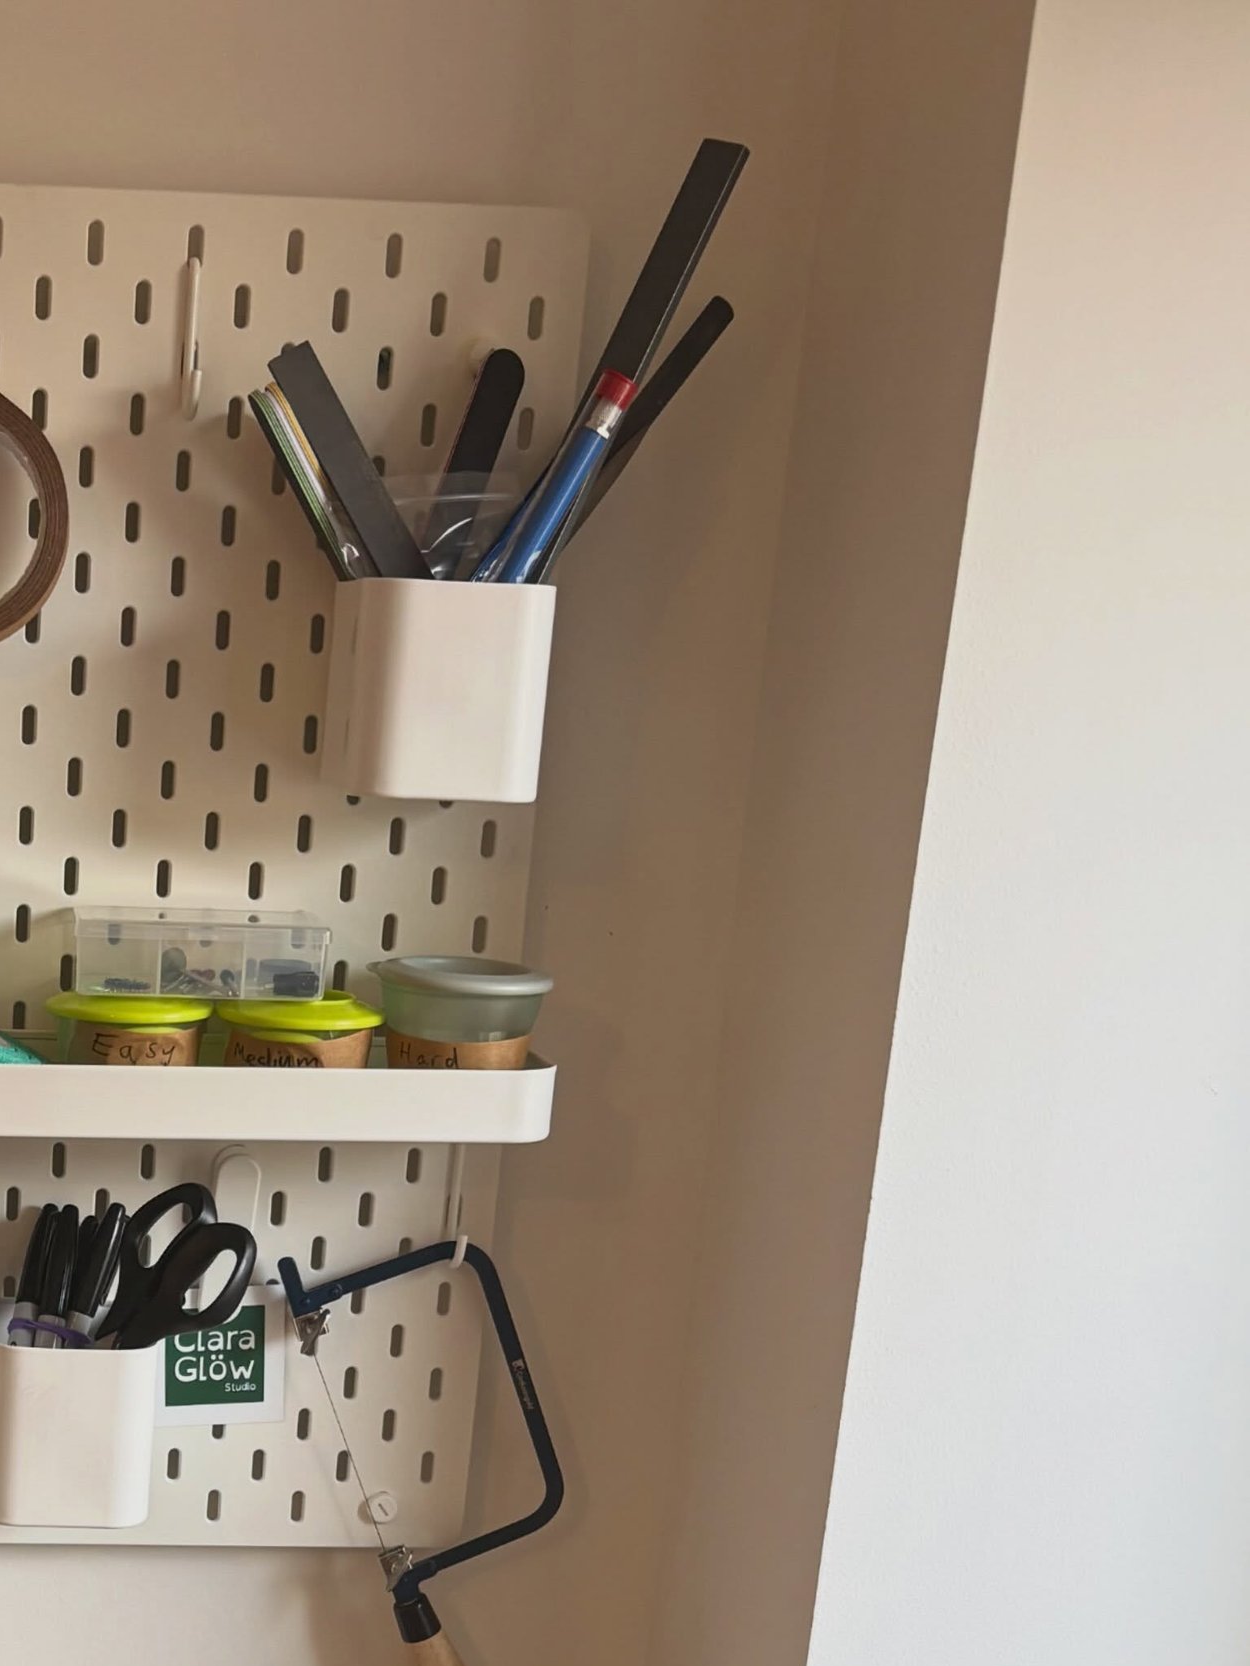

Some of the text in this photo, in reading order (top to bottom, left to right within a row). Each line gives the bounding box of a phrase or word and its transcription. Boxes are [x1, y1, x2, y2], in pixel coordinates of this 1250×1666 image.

[91, 1032, 175, 1066] Easy
[233, 1041, 325, 1068] Medium
[398, 1040, 461, 1069] Hard
[173, 1329, 256, 1353] Clara
[174, 1354, 255, 1383] Glöw
[224, 1381, 257, 1392] Studio
